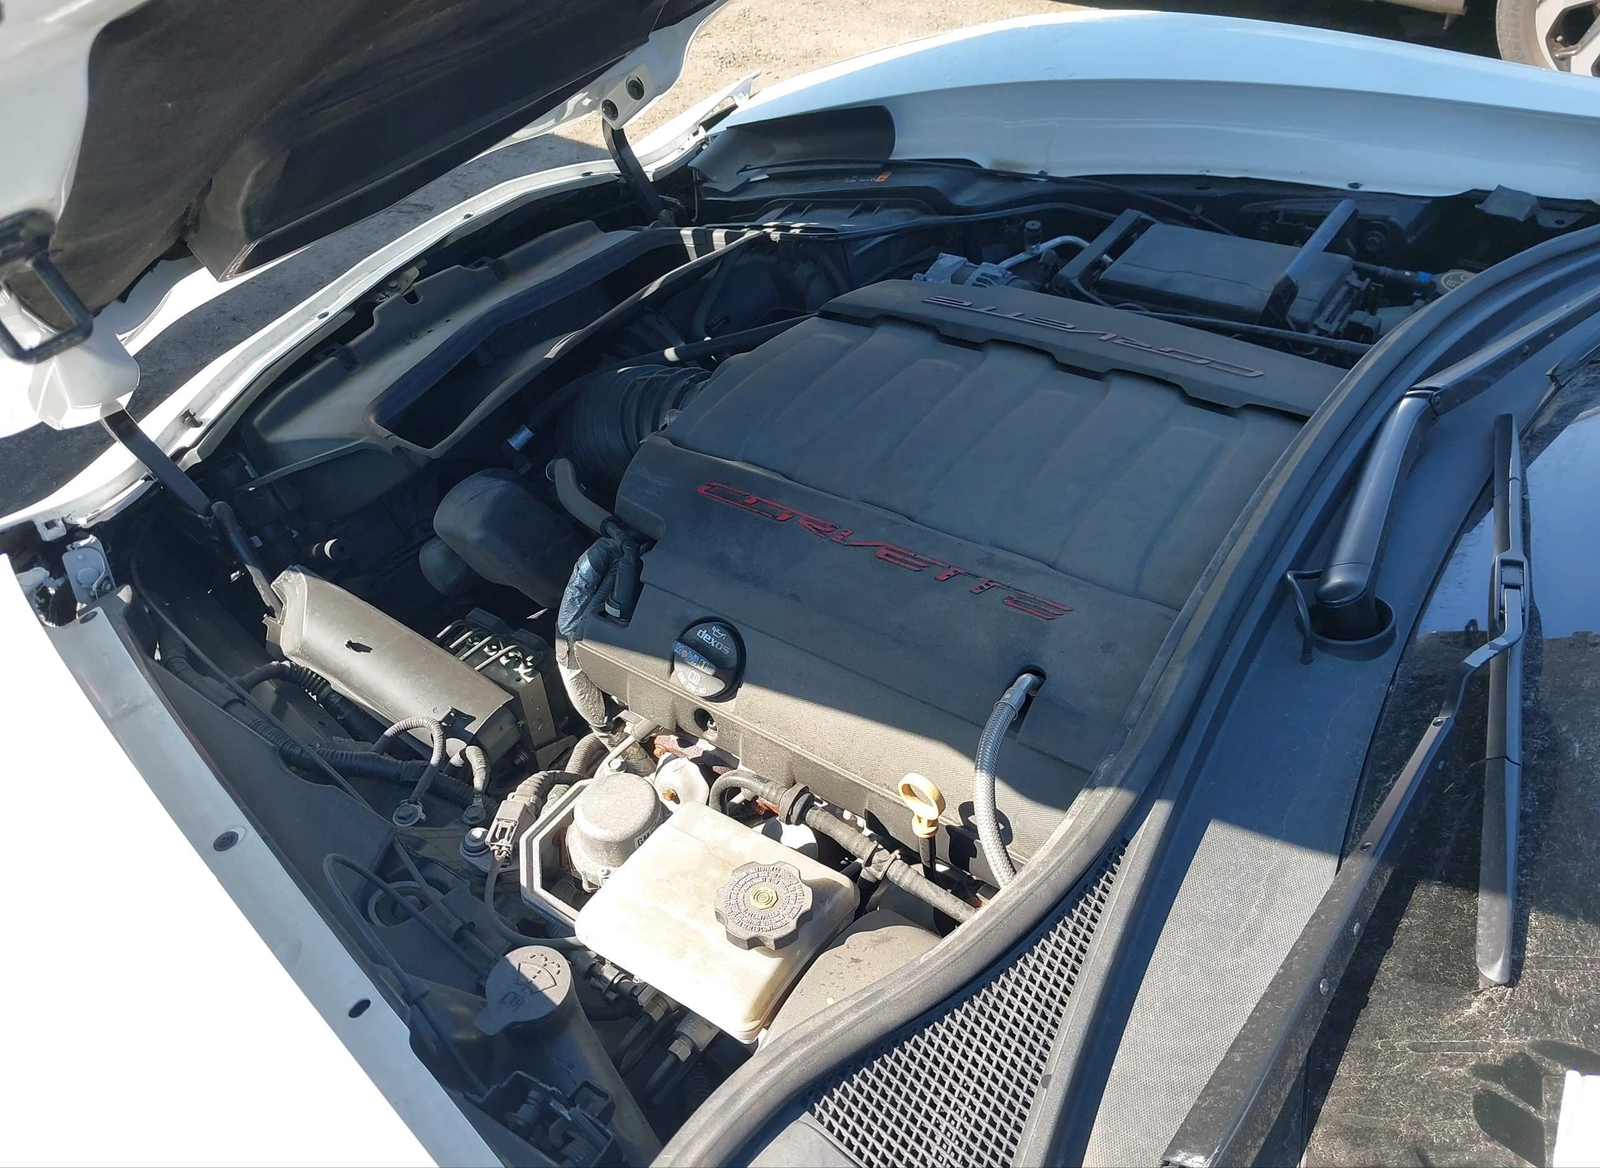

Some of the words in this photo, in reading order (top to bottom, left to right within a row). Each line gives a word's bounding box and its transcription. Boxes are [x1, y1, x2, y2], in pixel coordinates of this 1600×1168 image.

[921, 295, 1265, 377] CORVETTE
[697, 481, 1074, 620] CORVETTE
[696, 628, 732, 655] dexos
